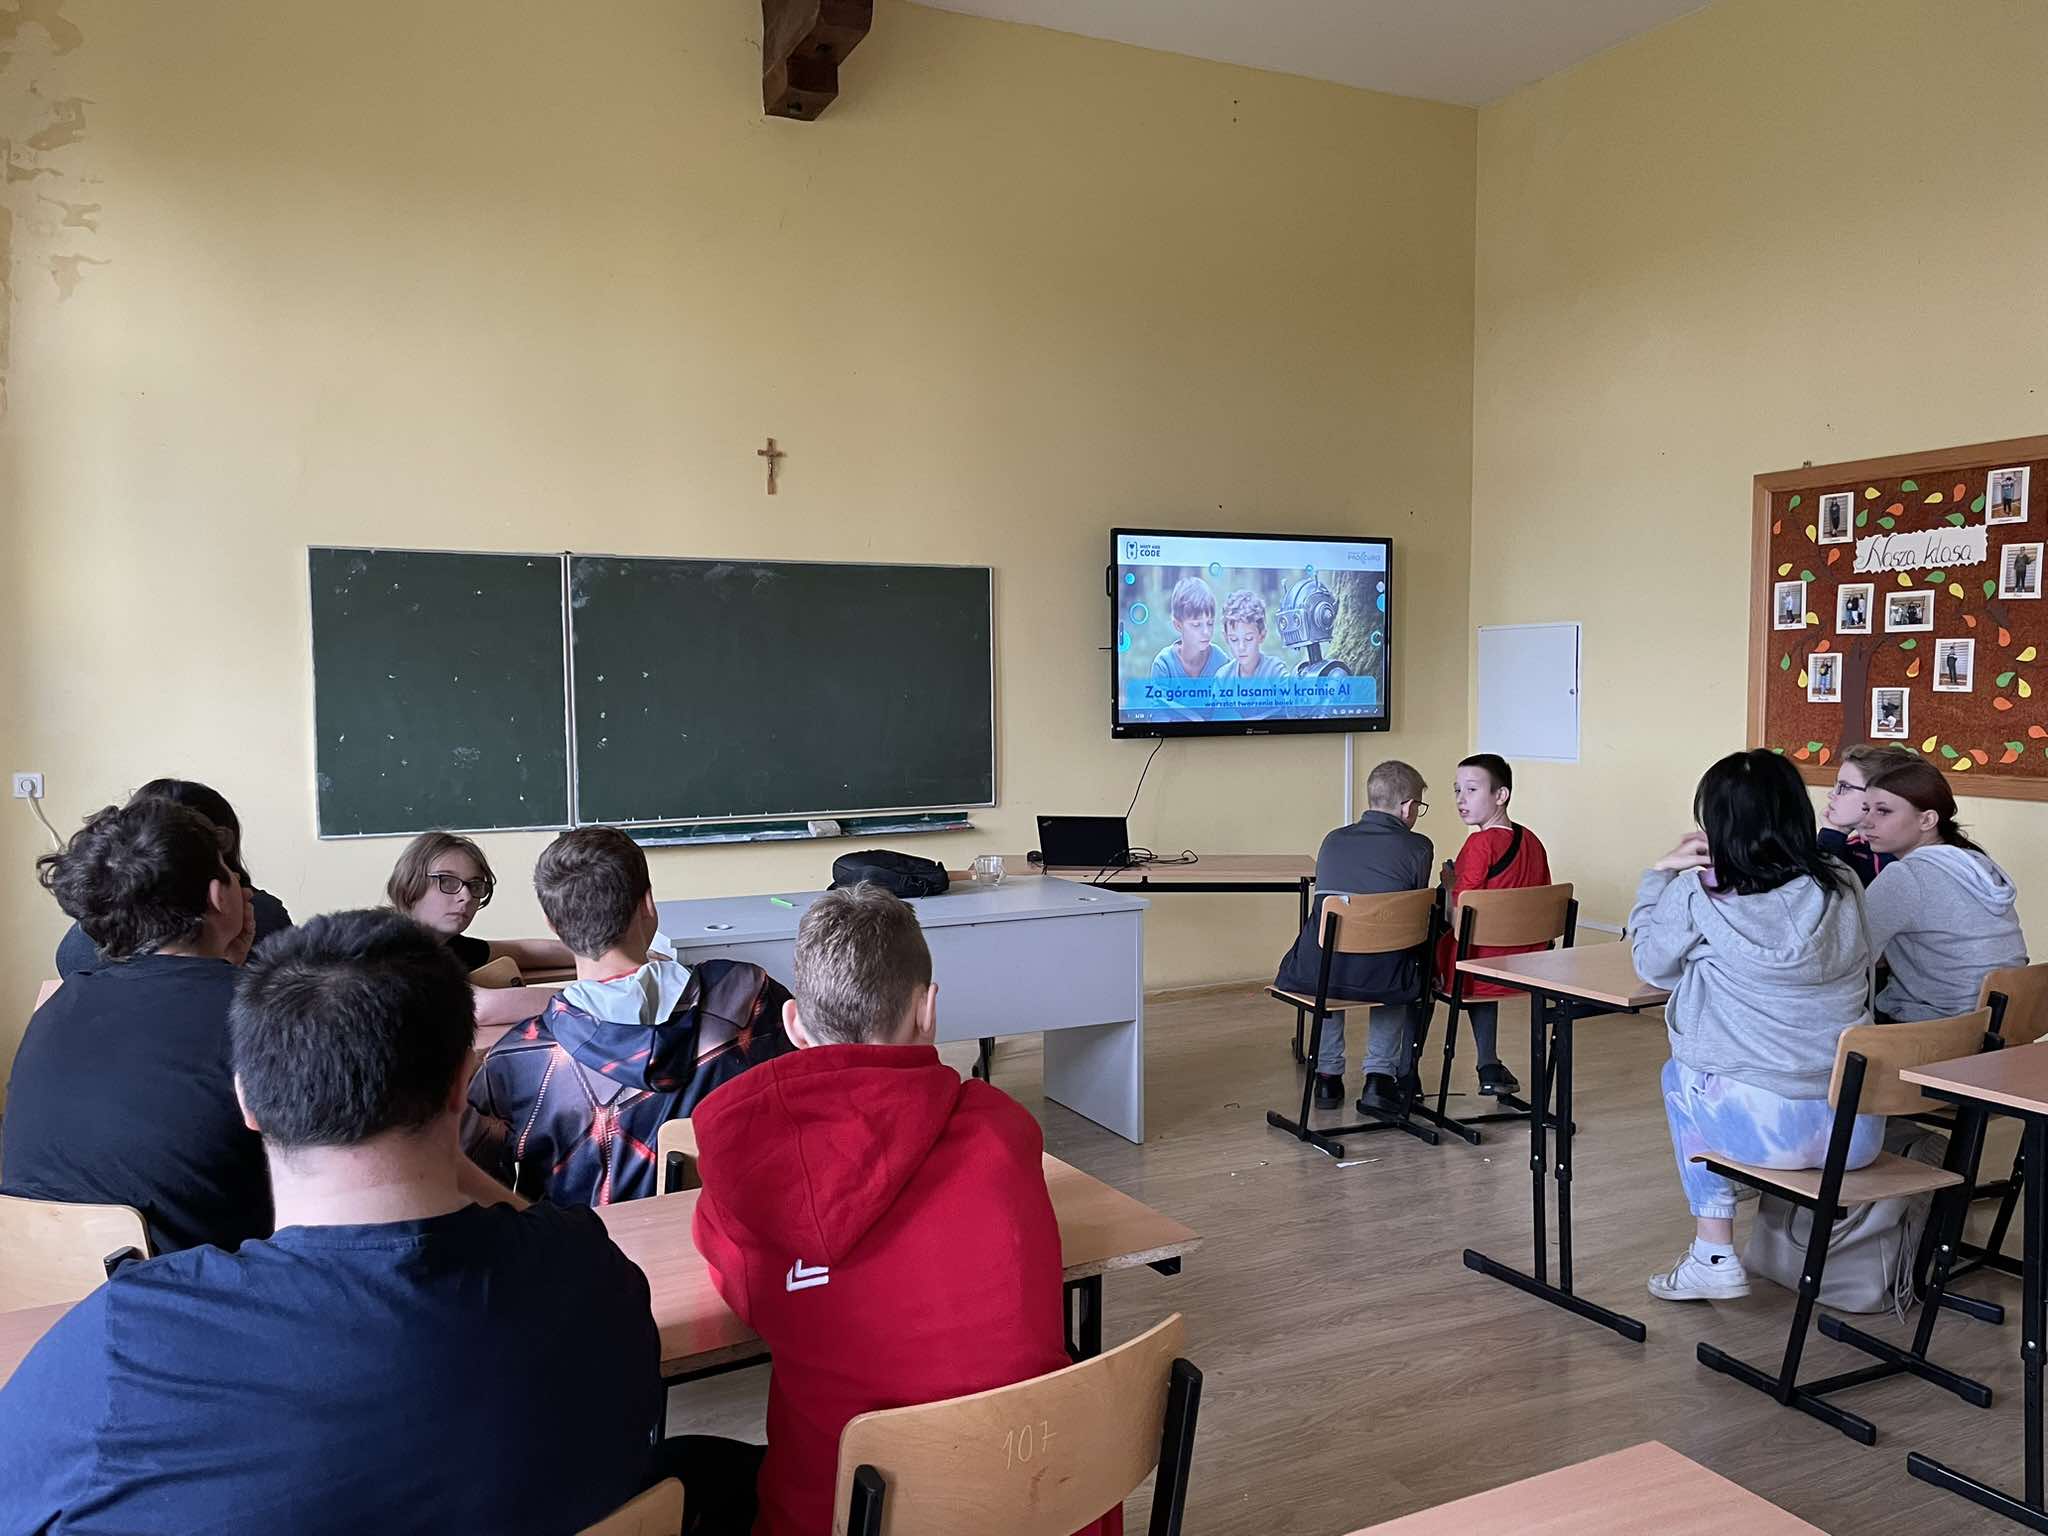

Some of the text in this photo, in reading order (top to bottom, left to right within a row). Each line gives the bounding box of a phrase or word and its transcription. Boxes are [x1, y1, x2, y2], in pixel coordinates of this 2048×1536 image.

[1140, 549, 1160, 557] CODE
[1858, 535, 1972, 569] Nasza klasa
[1145, 683, 1351, 701] Za górami, za lasami w krainie AI
[1001, 1420, 1057, 1470] 107
